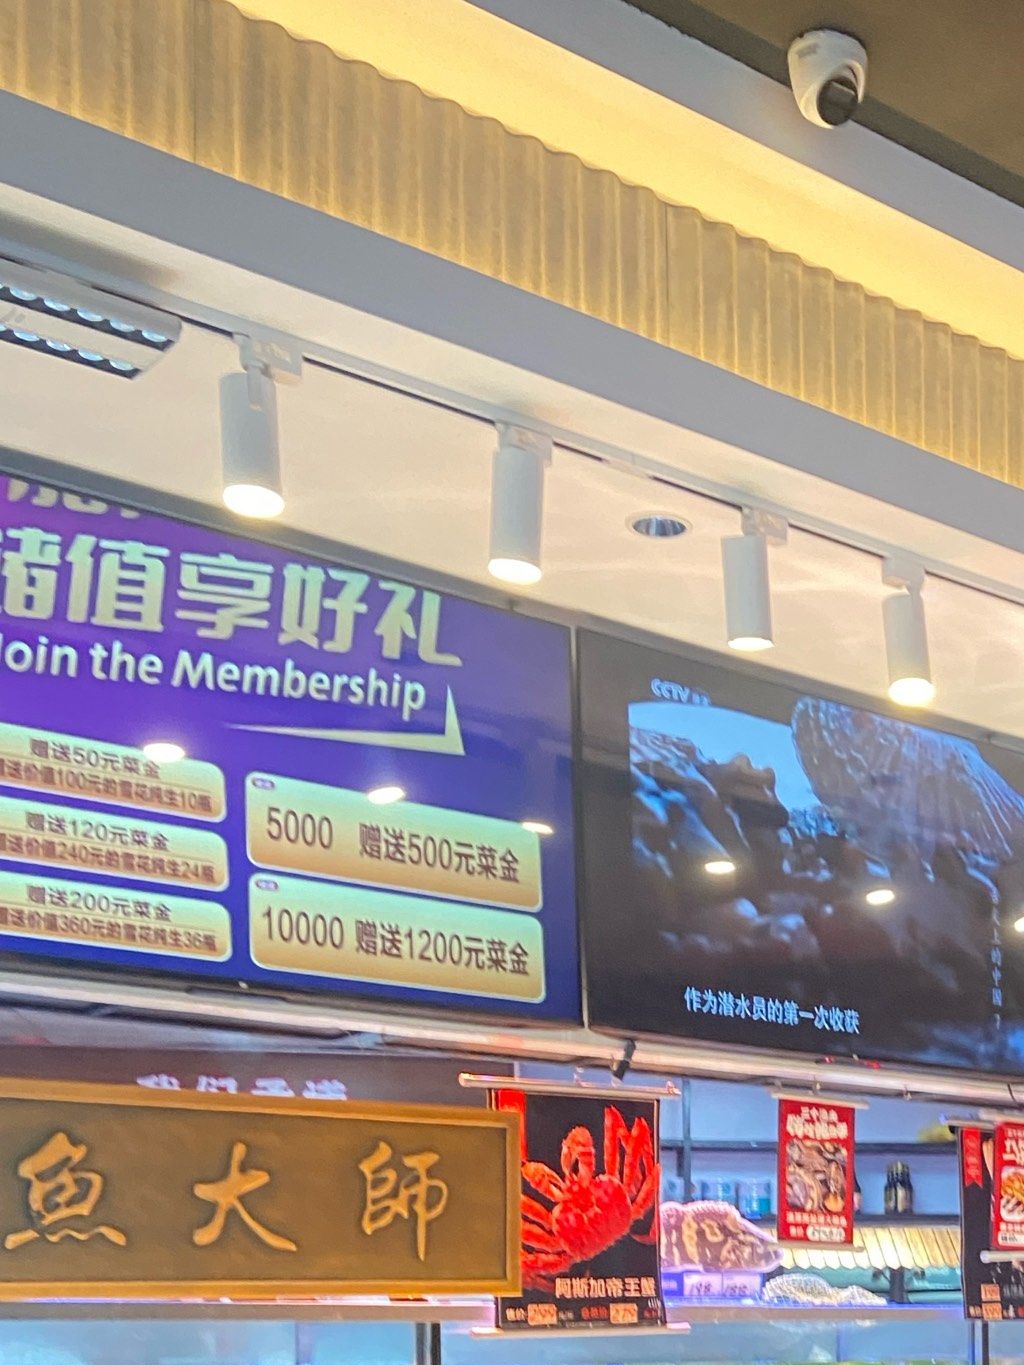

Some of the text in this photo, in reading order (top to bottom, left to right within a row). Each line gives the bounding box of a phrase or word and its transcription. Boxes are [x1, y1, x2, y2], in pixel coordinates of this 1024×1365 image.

[0, 526, 463, 667] 储值享好礼
[0, 632, 426, 718] oin the Membership
[266, 805, 520, 884] 5000 赠送500元菜金
[262, 904, 530, 977] 10000 赠送1200元菜金
[684, 985, 861, 1035] 作为潜水员的第一次收获
[3, 1130, 450, 1263] 魚大師
